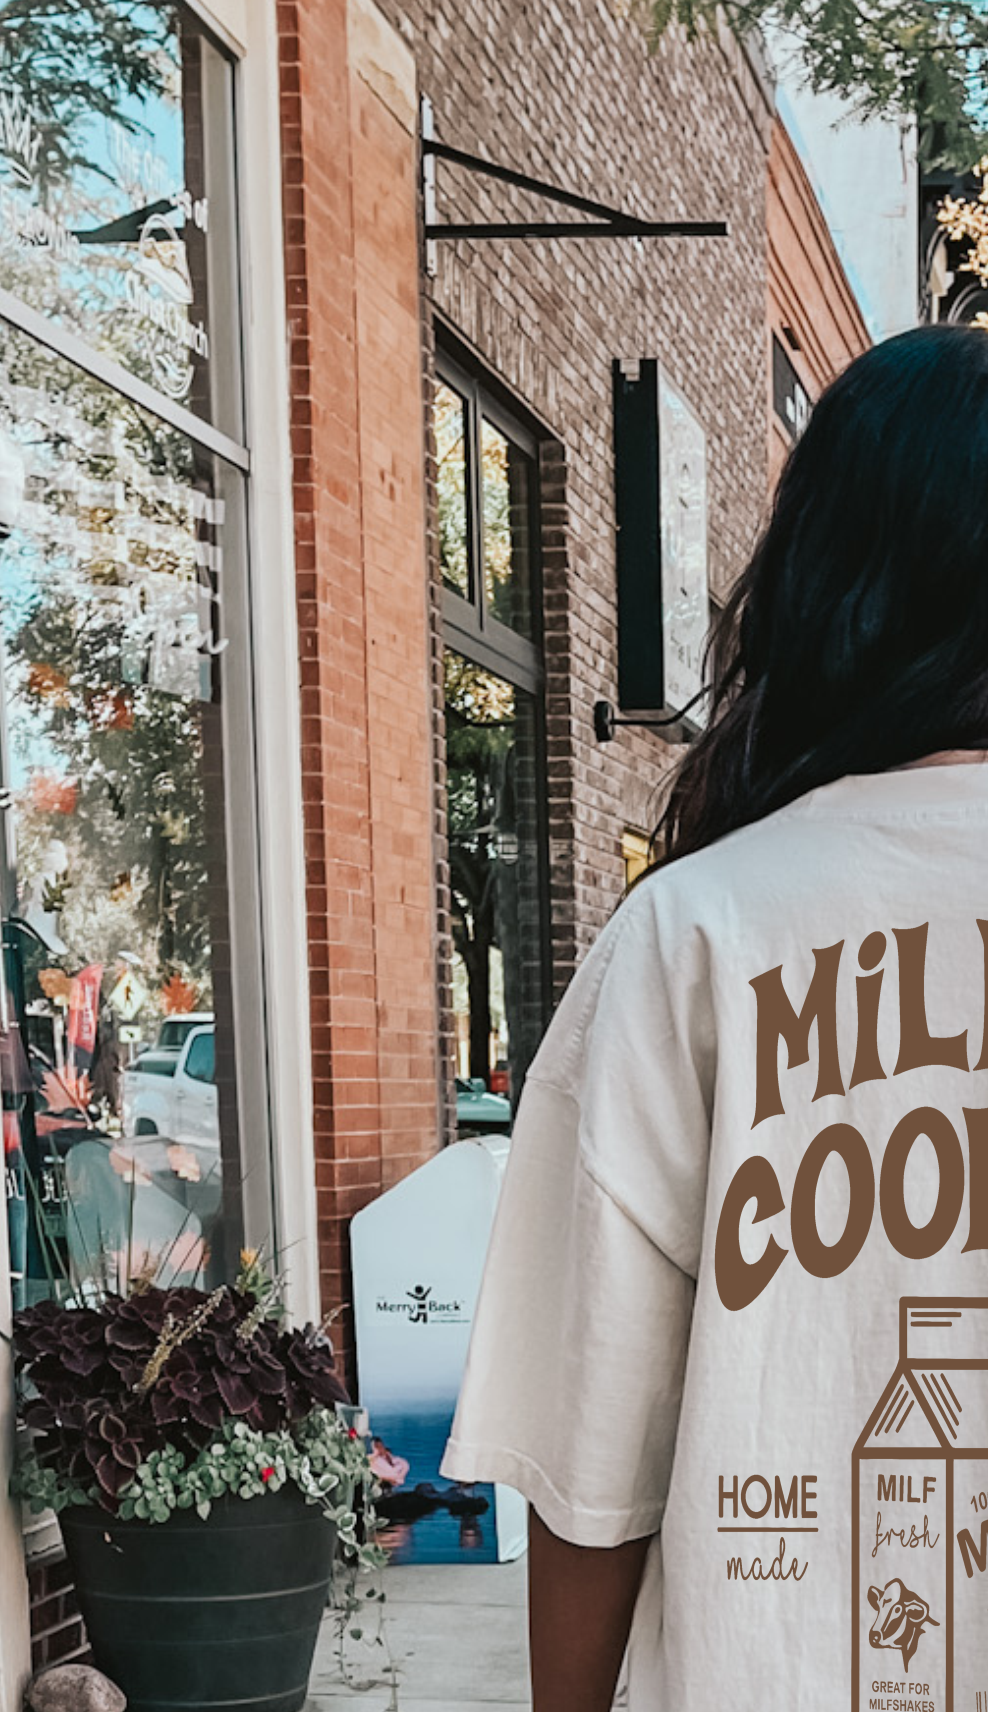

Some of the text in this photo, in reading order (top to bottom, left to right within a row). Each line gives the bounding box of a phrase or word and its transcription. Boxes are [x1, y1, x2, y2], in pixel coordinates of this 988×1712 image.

[376, 1300, 461, 1315] Merry Back
[718, 1474, 818, 1520] HOME
[877, 1474, 937, 1504] MILF
[871, 1511, 940, 1558] fresh
[726, 1536, 809, 1582] made
[871, 1680, 930, 1696] GREAT FOR
[869, 1698, 935, 1712] MILFSHAKES
